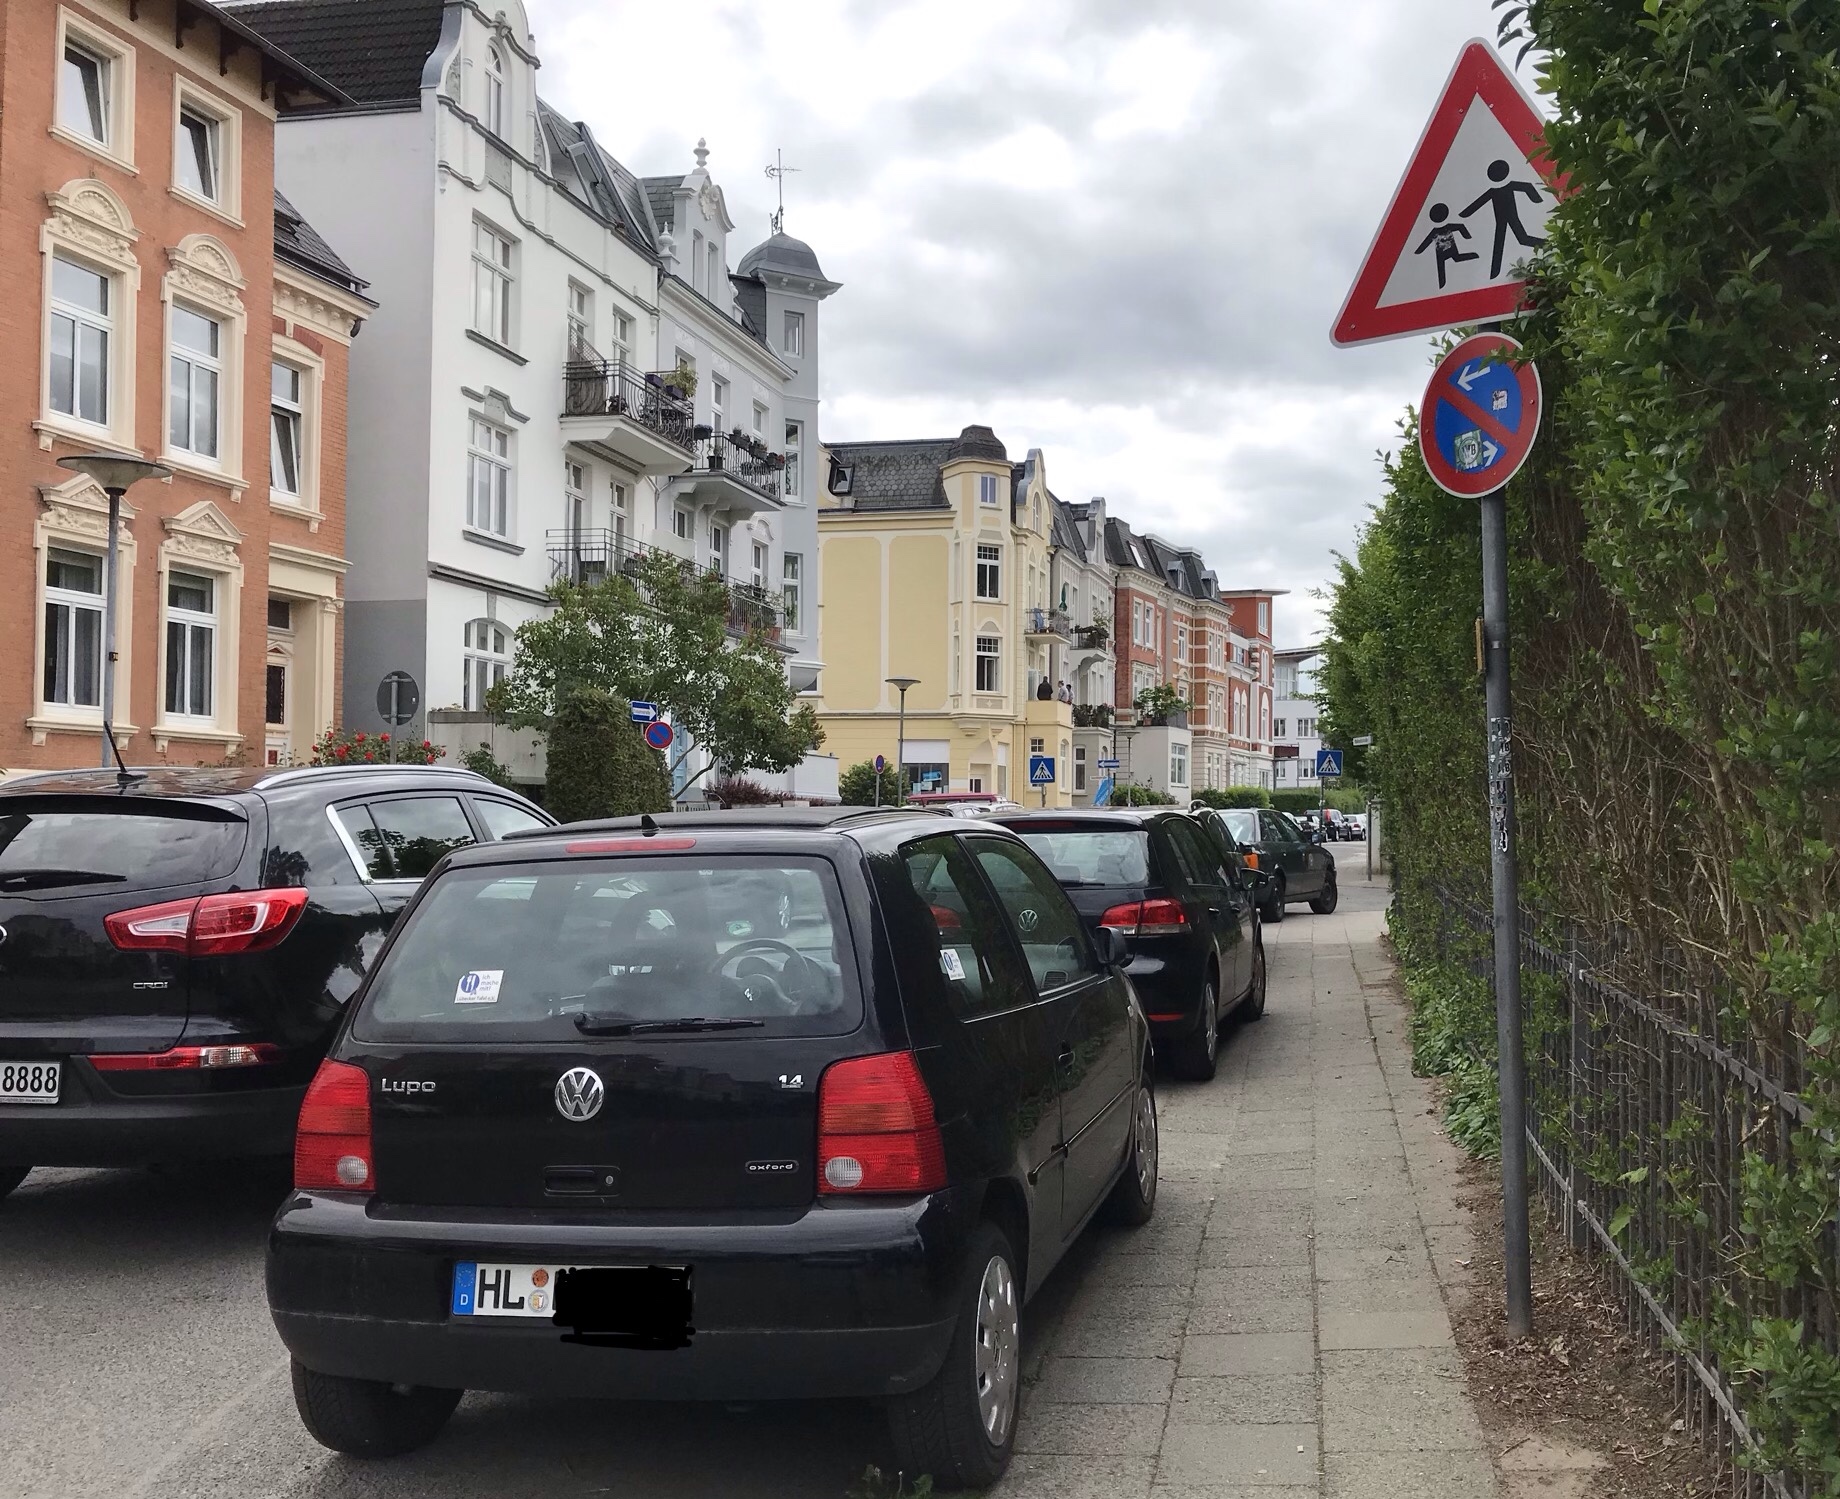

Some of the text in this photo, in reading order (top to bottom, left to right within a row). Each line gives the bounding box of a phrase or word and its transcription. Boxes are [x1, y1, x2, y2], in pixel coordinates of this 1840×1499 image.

[2, 1066, 57, 1093] 8888
[381, 1078, 437, 1095] Lupo
[749, 1163, 793, 1171] oxford
[460, 1293, 469, 1306] D
[478, 1269, 525, 1310] HL
